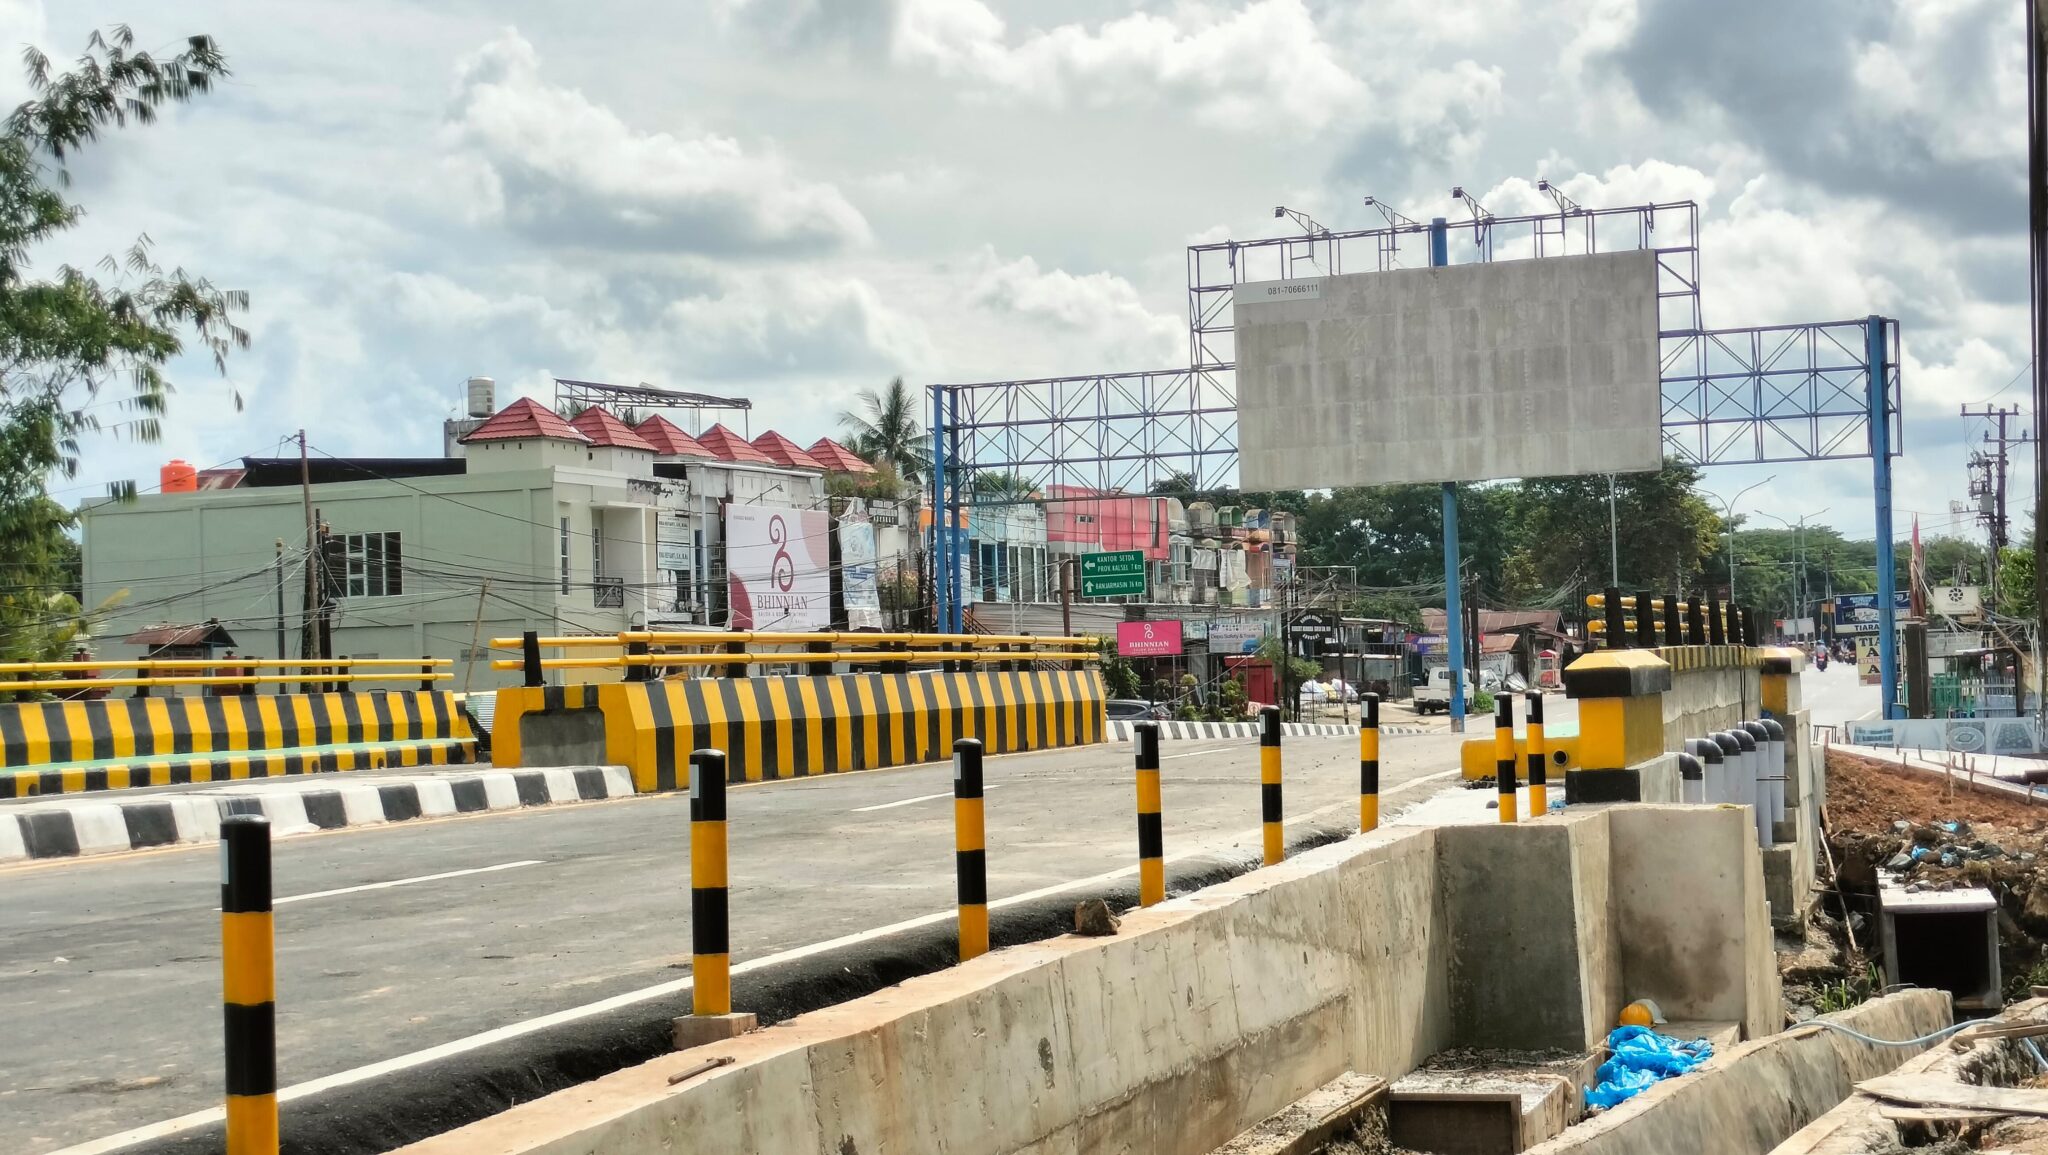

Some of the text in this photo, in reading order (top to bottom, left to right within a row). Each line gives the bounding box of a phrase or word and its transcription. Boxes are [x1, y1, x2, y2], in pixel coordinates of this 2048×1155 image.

[1268, 284, 1318, 295] 081-70666111
[1095, 581, 1128, 589] BANJARMASIN
[757, 594, 808, 610] BHINNIAN
